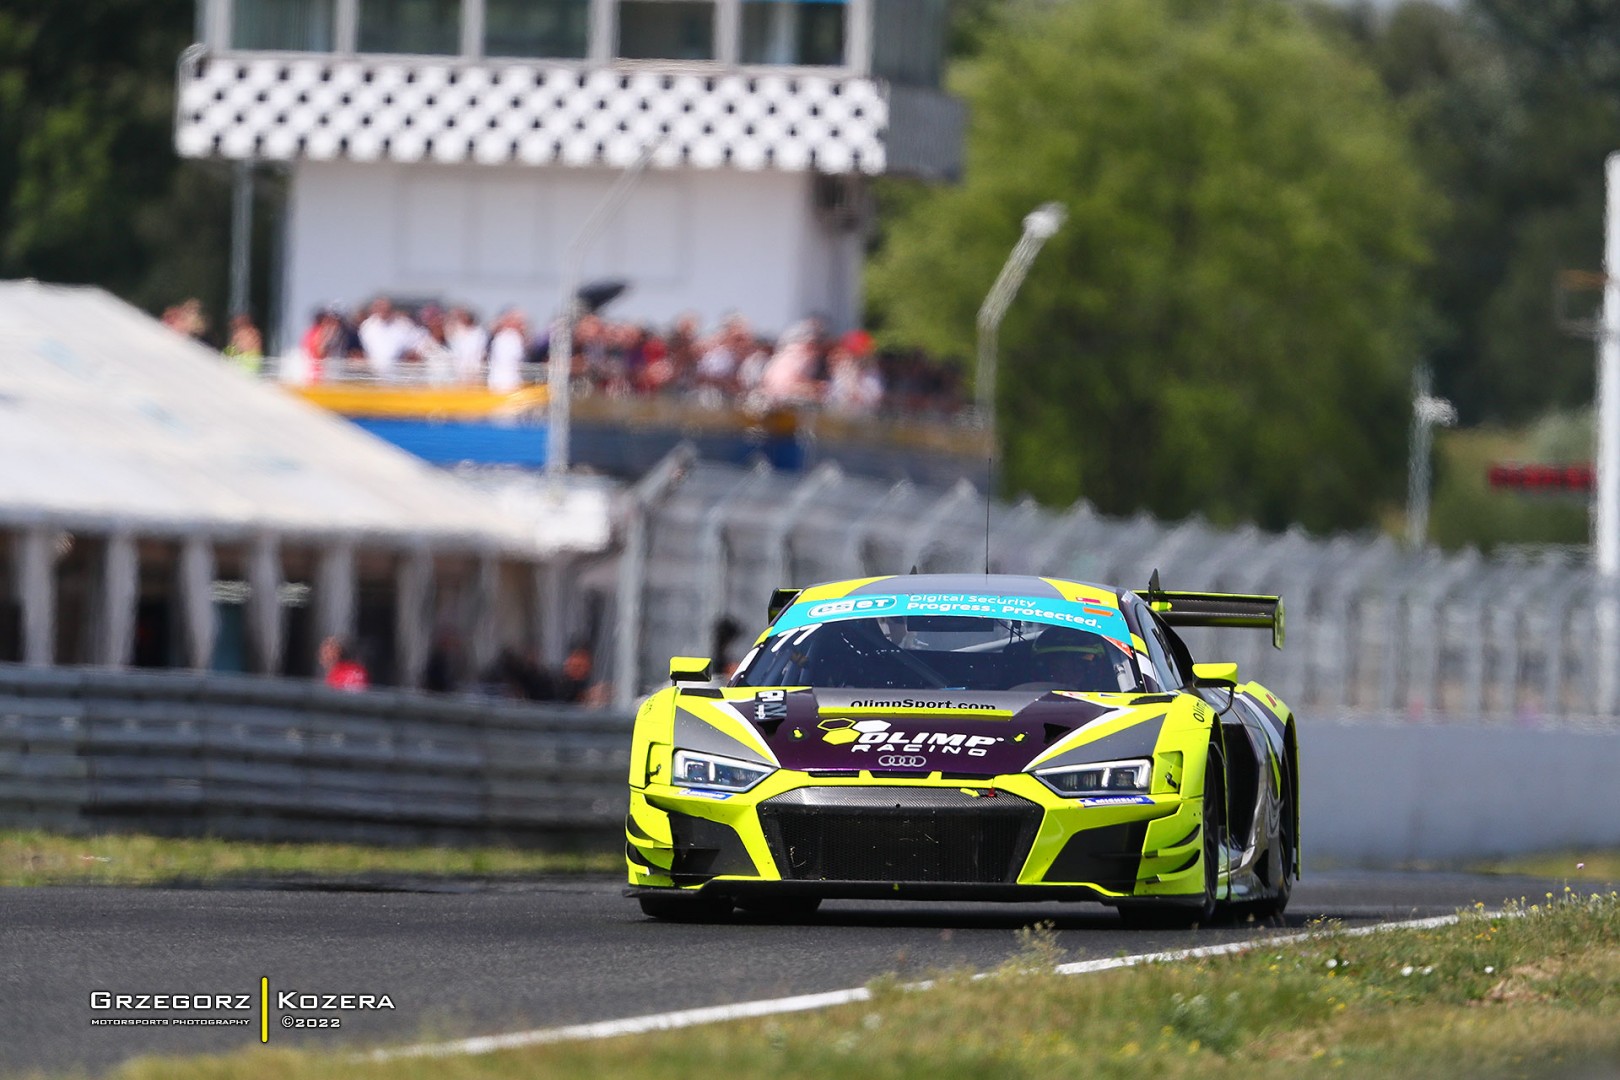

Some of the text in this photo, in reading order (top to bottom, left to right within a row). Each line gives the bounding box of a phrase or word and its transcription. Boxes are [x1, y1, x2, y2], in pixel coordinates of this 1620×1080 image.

[909, 594, 1036, 608] Digital Security
[906, 602, 1102, 629] Progress. Protected.
[858, 731, 997, 747] OLIMP
[850, 743, 988, 757] RACING
